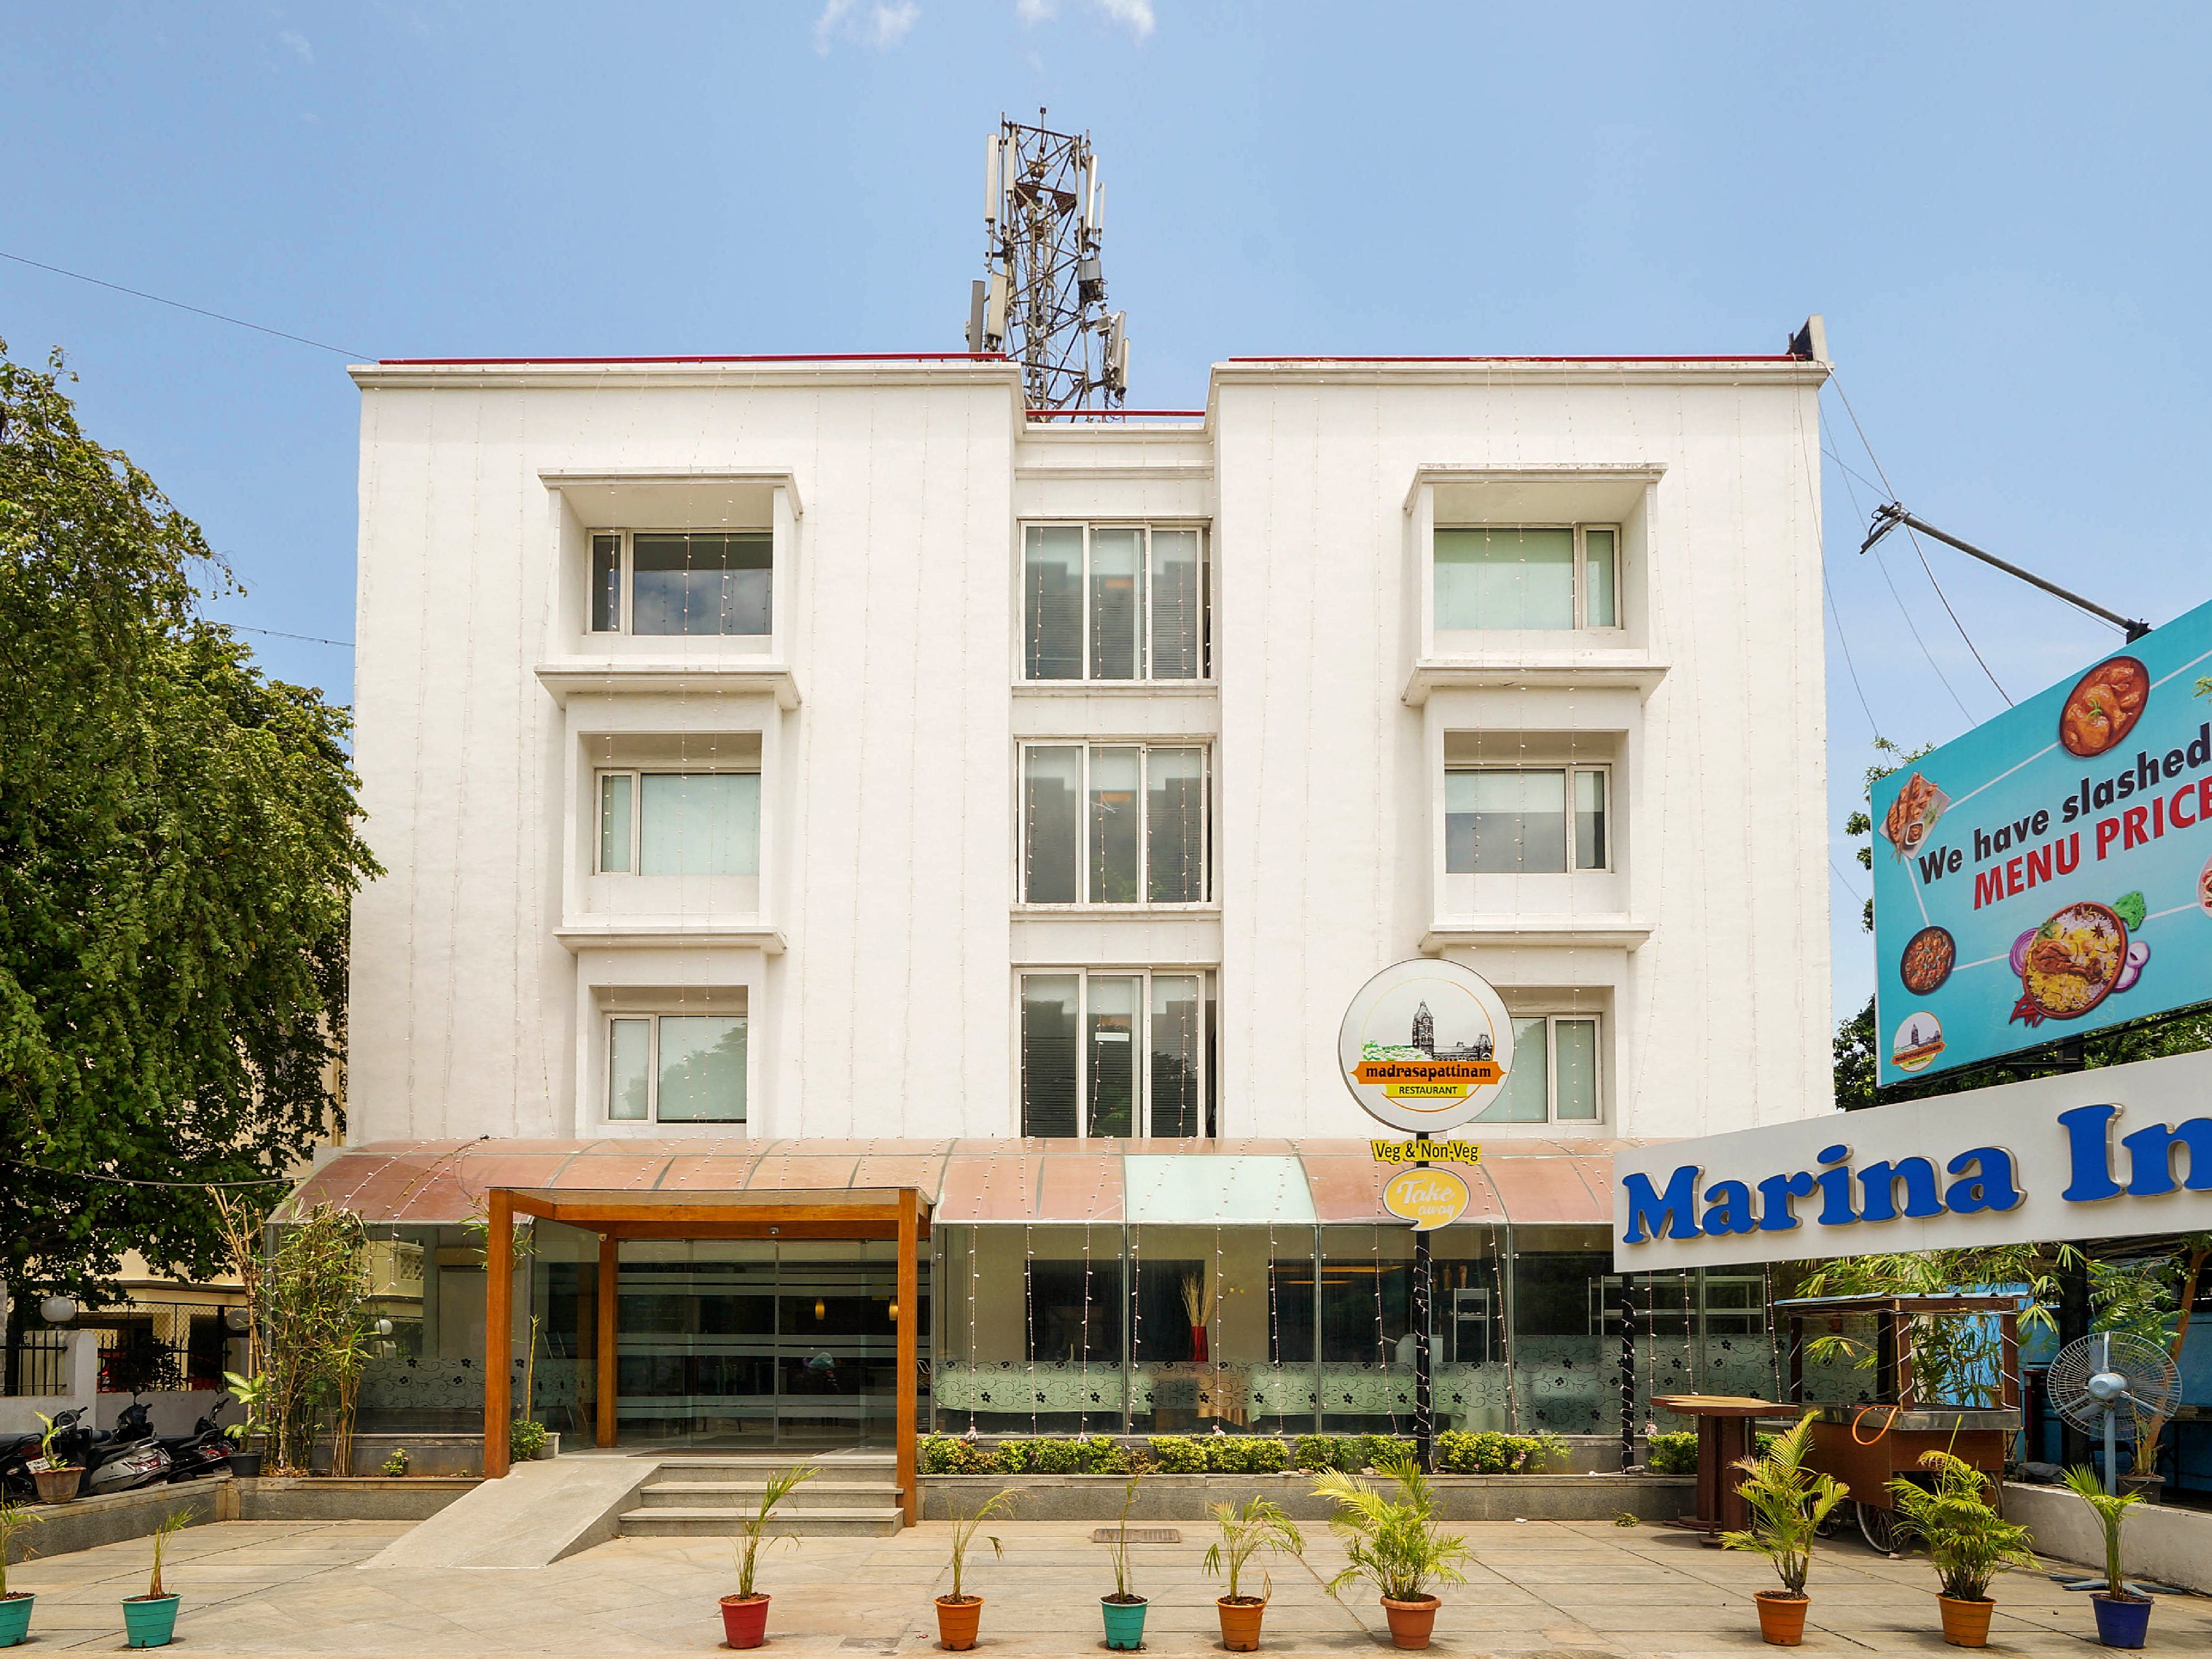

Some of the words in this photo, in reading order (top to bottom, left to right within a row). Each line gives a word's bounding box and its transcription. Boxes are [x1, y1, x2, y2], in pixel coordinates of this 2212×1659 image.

[1919, 846, 1963, 885] We
[1974, 809, 2050, 863] have
[2062, 721, 2211, 824] slashed
[1974, 831, 2080, 911] MENU
[1366, 1064, 1491, 1082] madrasapattinam
[1399, 1086, 1458, 1095] RESTAURANT
[1376, 1142, 1401, 1161] Veg
[1406, 1142, 1416, 1158] &
[1421, 1142, 1479, 1161] Non-Veg
[1397, 1179, 1455, 1205] Take
[1622, 1144, 2028, 1244] Marina
[1418, 1204, 1455, 1219] away
